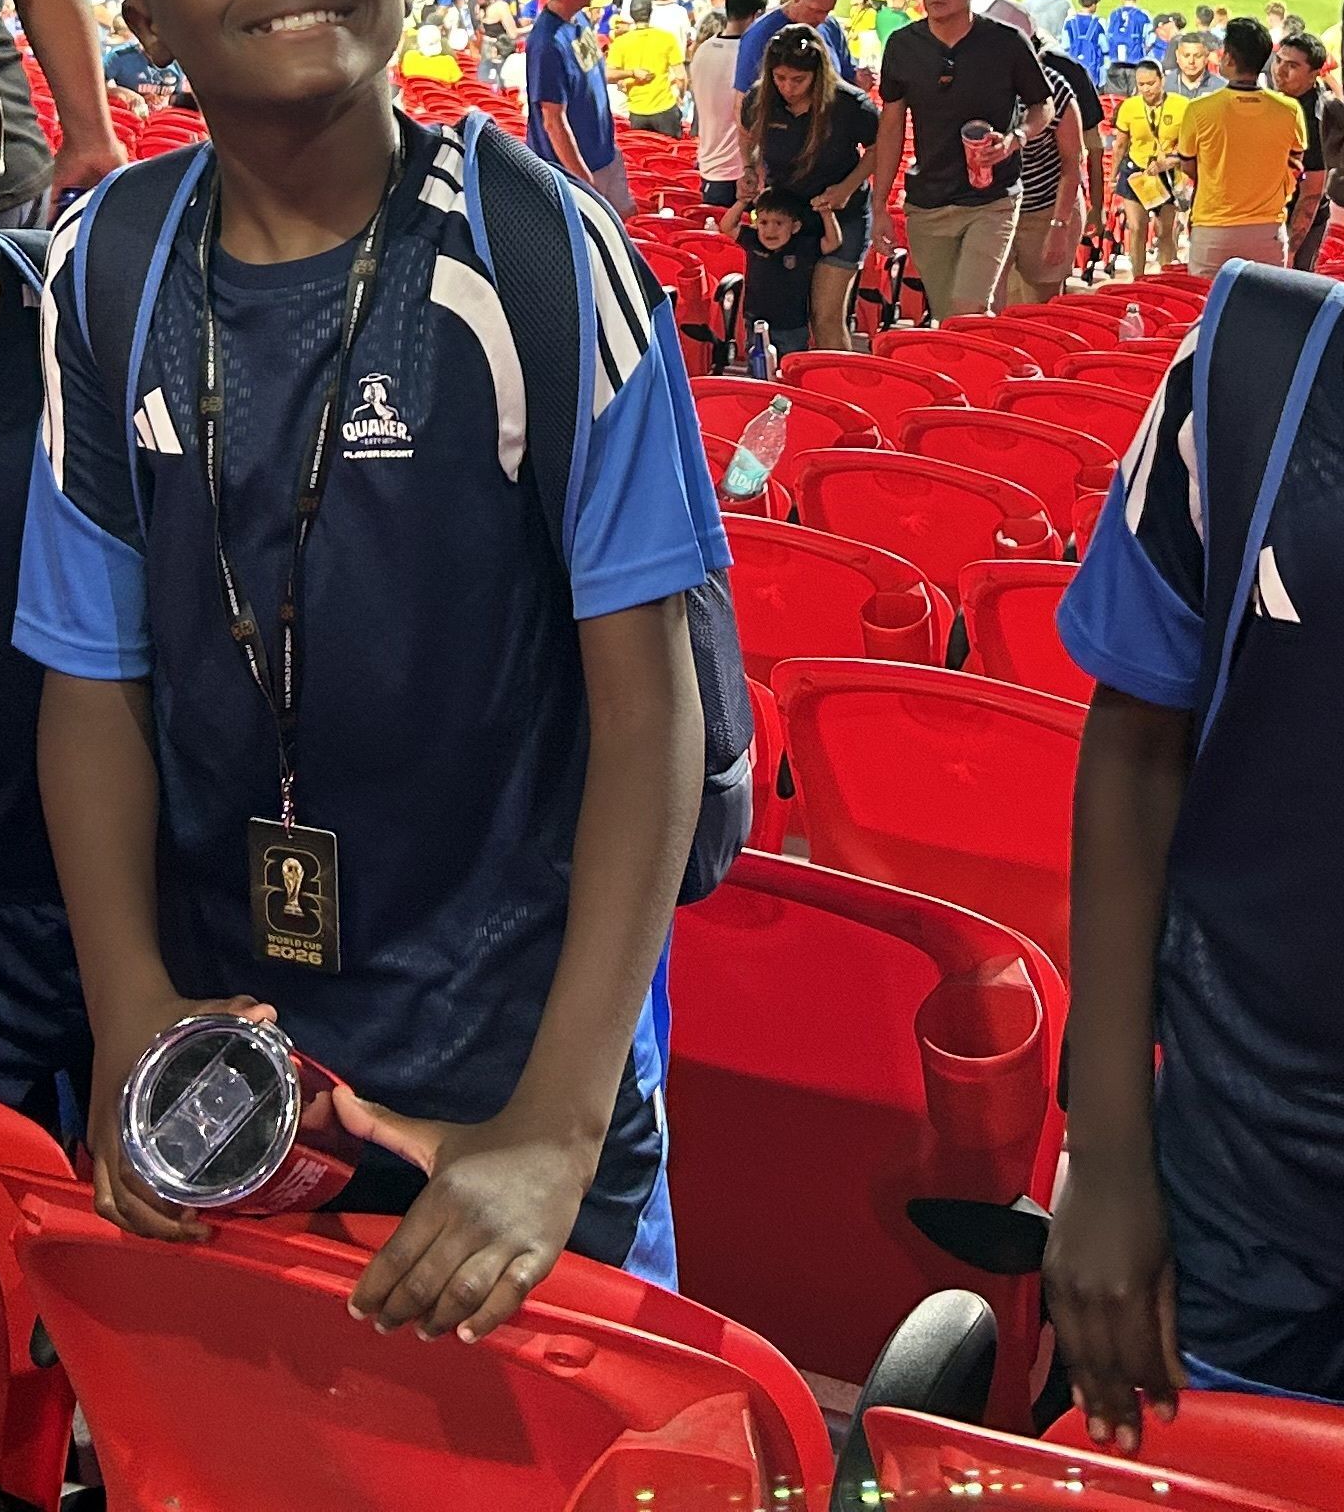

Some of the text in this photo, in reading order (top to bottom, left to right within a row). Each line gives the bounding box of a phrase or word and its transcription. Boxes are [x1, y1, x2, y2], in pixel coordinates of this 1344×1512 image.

[342, 418, 408, 442] QUAKER
[267, 933, 323, 952] WORLD CUP
[266, 944, 323, 966] 2026
